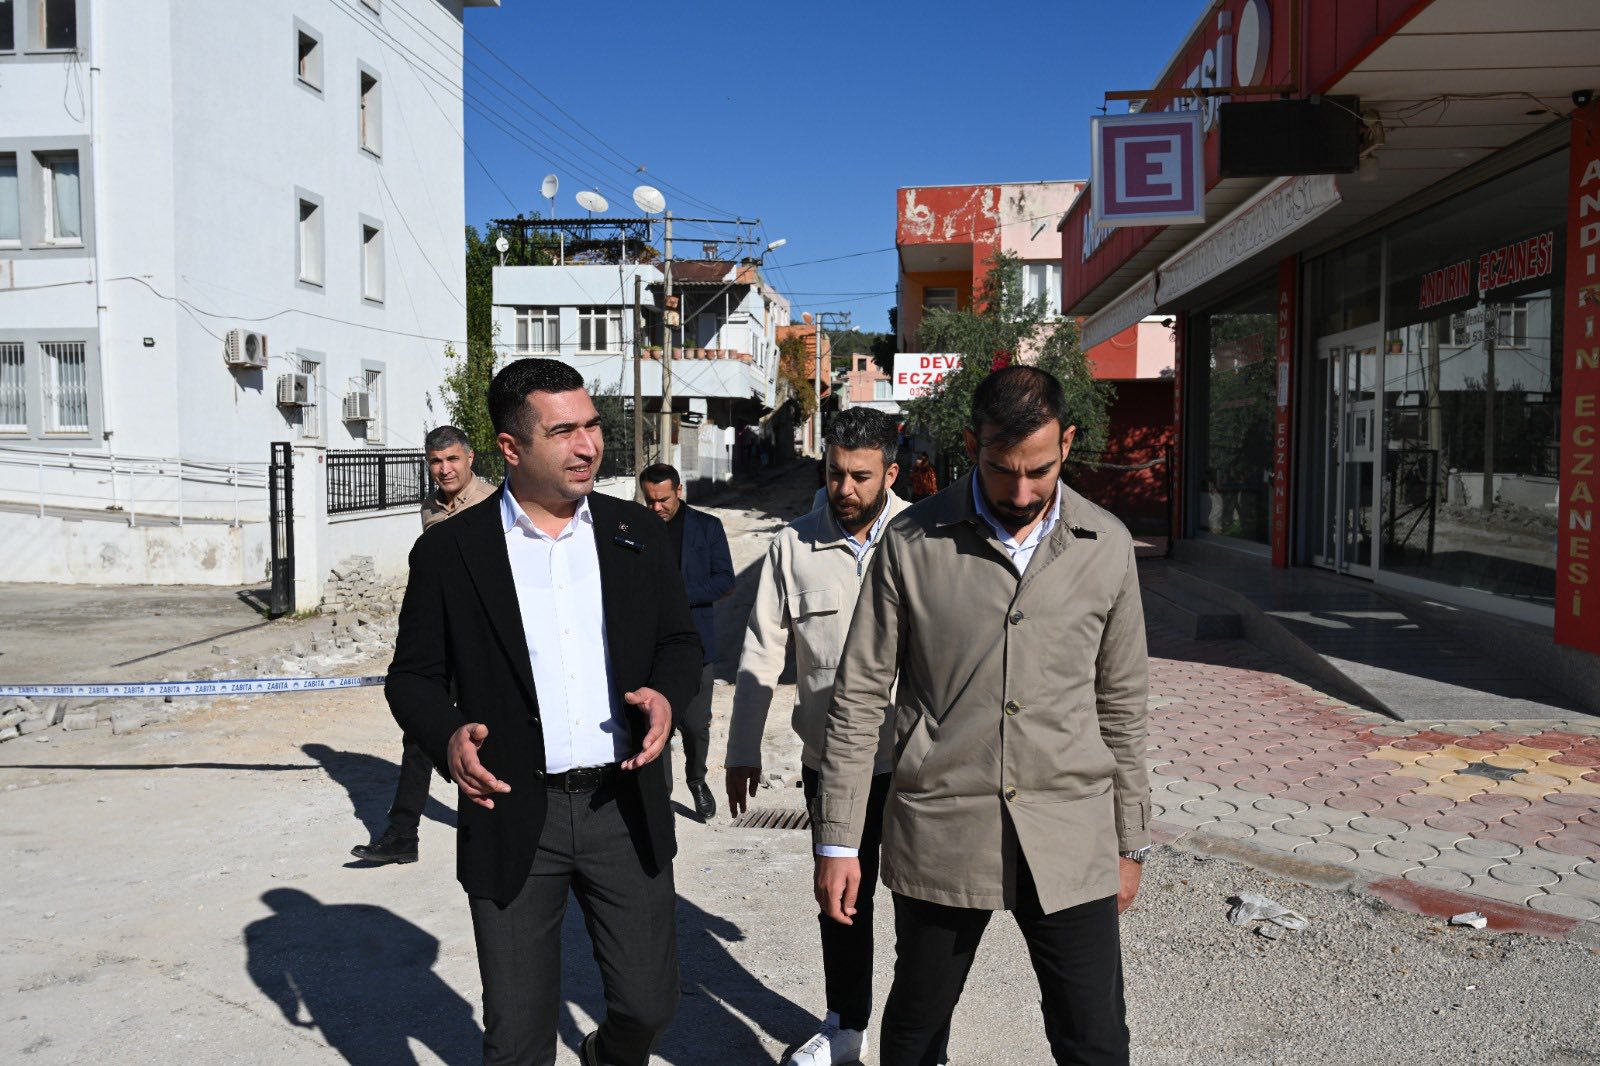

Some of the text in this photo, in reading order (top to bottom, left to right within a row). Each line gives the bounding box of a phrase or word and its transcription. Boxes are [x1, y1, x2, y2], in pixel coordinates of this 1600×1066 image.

[1124, 140, 1173, 198] E
[1418, 259, 1471, 309] ANDIRIN
[124, 686, 145, 694] ZABITA
[159, 685, 181, 693] ZABITA
[194, 685, 216, 693] ZABITA
[231, 684, 253, 692] ZABITA
[267, 682, 289, 690] ZABITA
[303, 680, 325, 688] ZABITA
[339, 678, 362, 686] ZABITA
